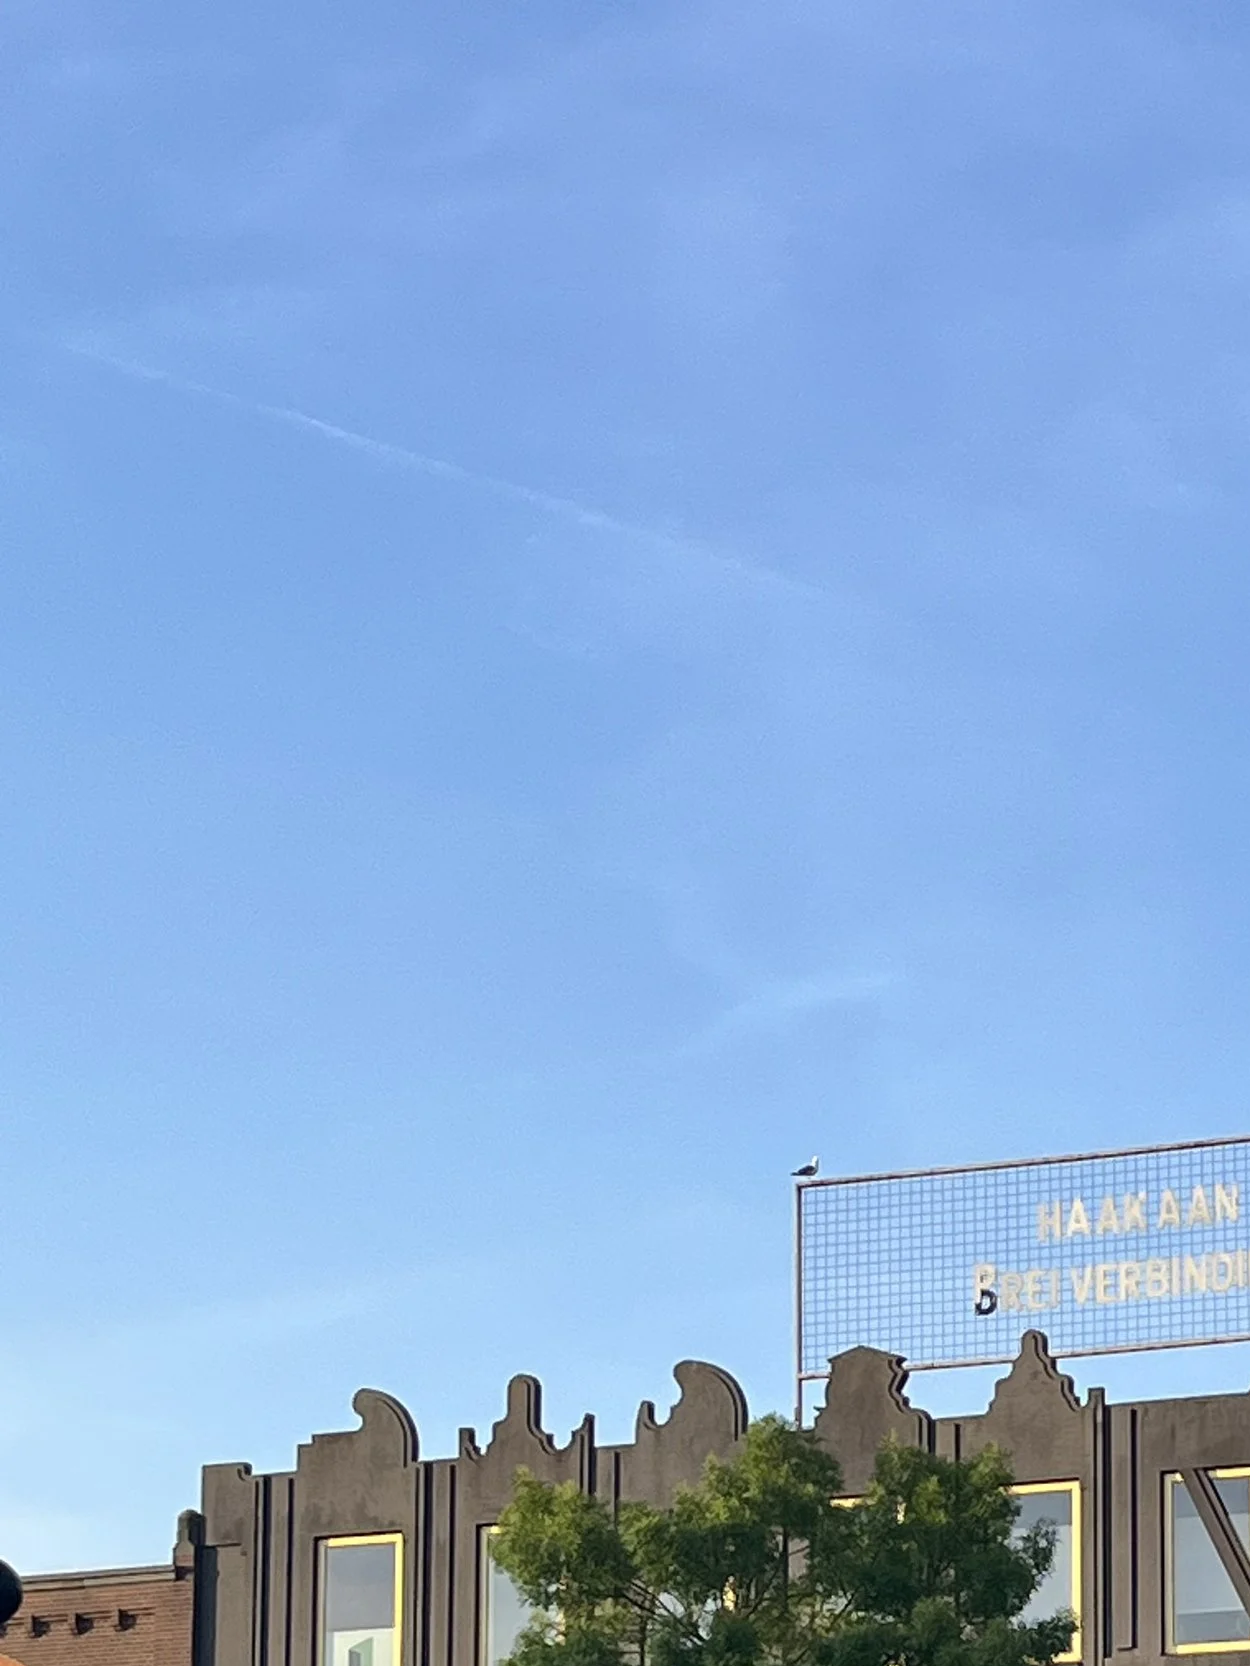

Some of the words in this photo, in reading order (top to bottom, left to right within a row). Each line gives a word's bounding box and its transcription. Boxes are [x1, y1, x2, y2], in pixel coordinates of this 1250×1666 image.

[1036, 1190, 1148, 1243] HAAK
[1157, 1182, 1240, 1231] AAN
[974, 1262, 1061, 1316] BREI
